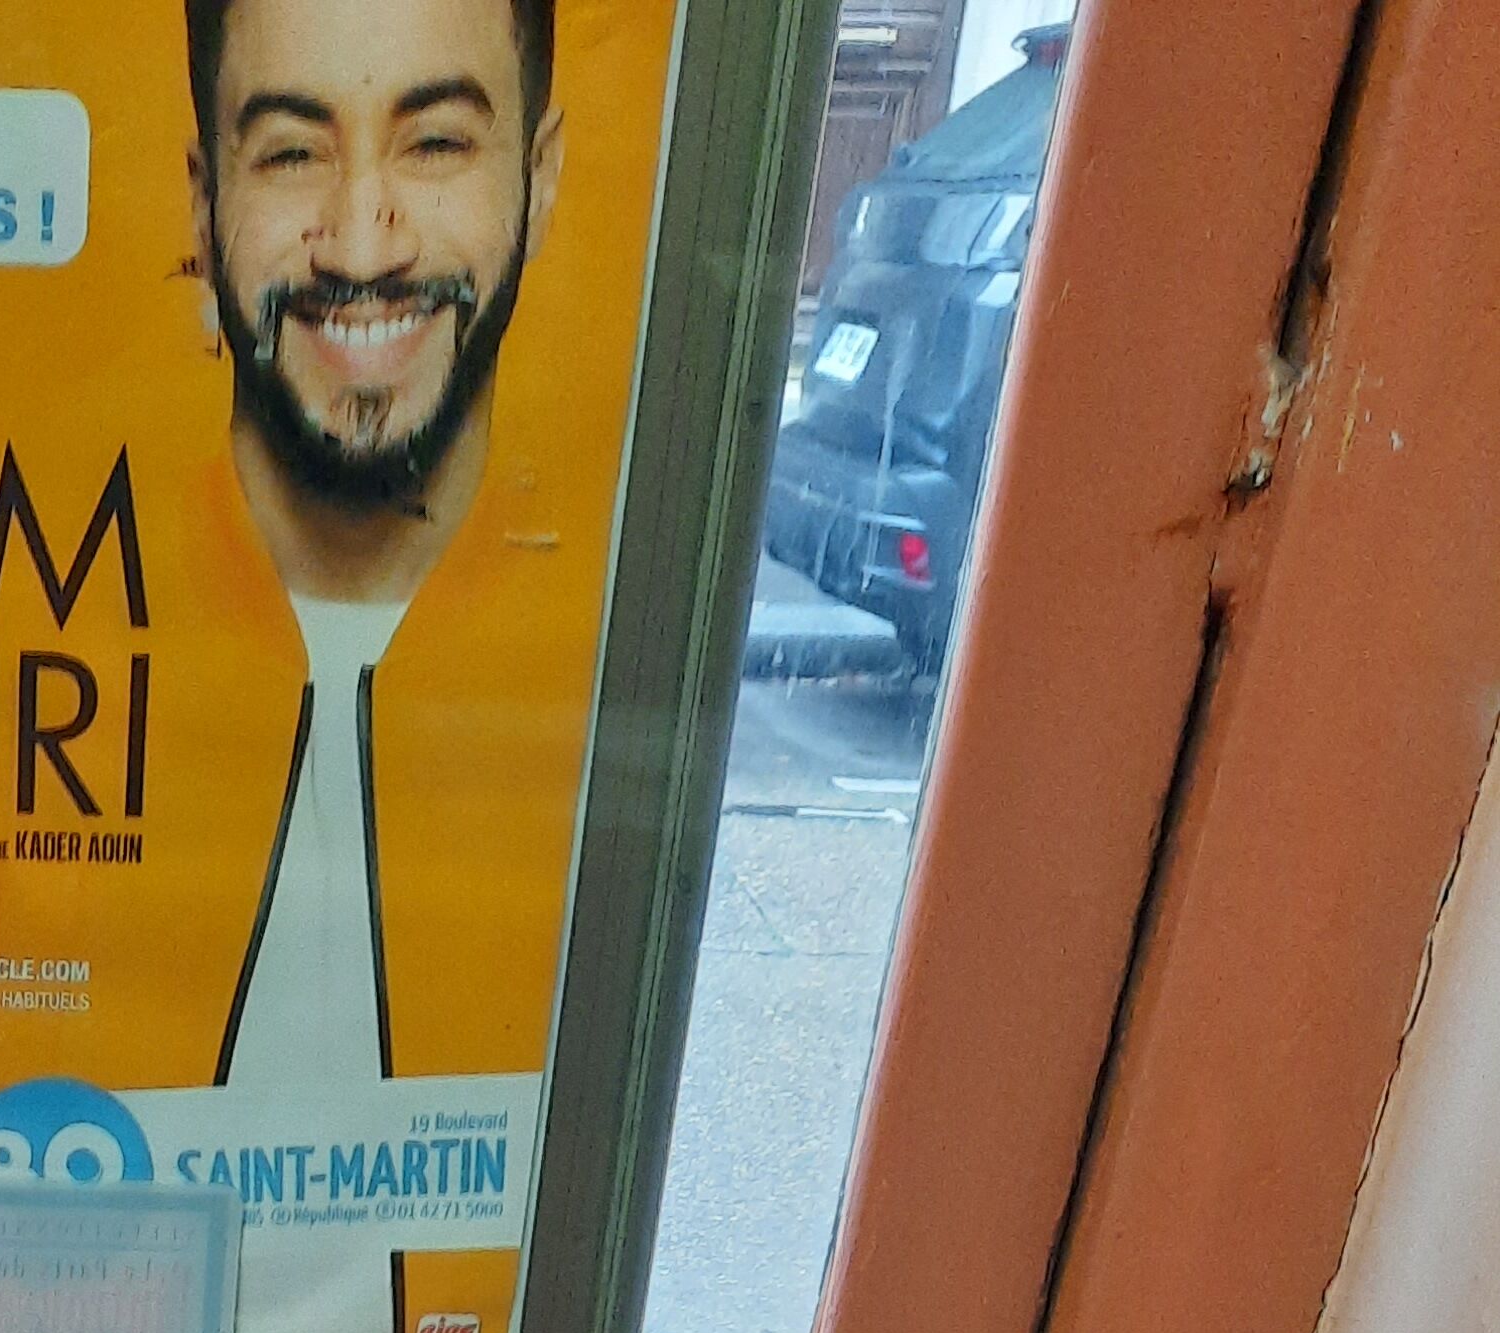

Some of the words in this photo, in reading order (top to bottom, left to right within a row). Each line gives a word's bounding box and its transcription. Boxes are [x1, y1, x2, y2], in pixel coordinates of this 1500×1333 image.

[40, 191, 56, 243] !
[15, 830, 81, 863] KADER
[87, 831, 143, 864] AOUN
[2, 990, 91, 1011] HABITUELS
[410, 1114, 429, 1132] 19
[435, 1109, 508, 1131] Boulevard
[176, 1136, 506, 1204] SAINT-MARTIN
